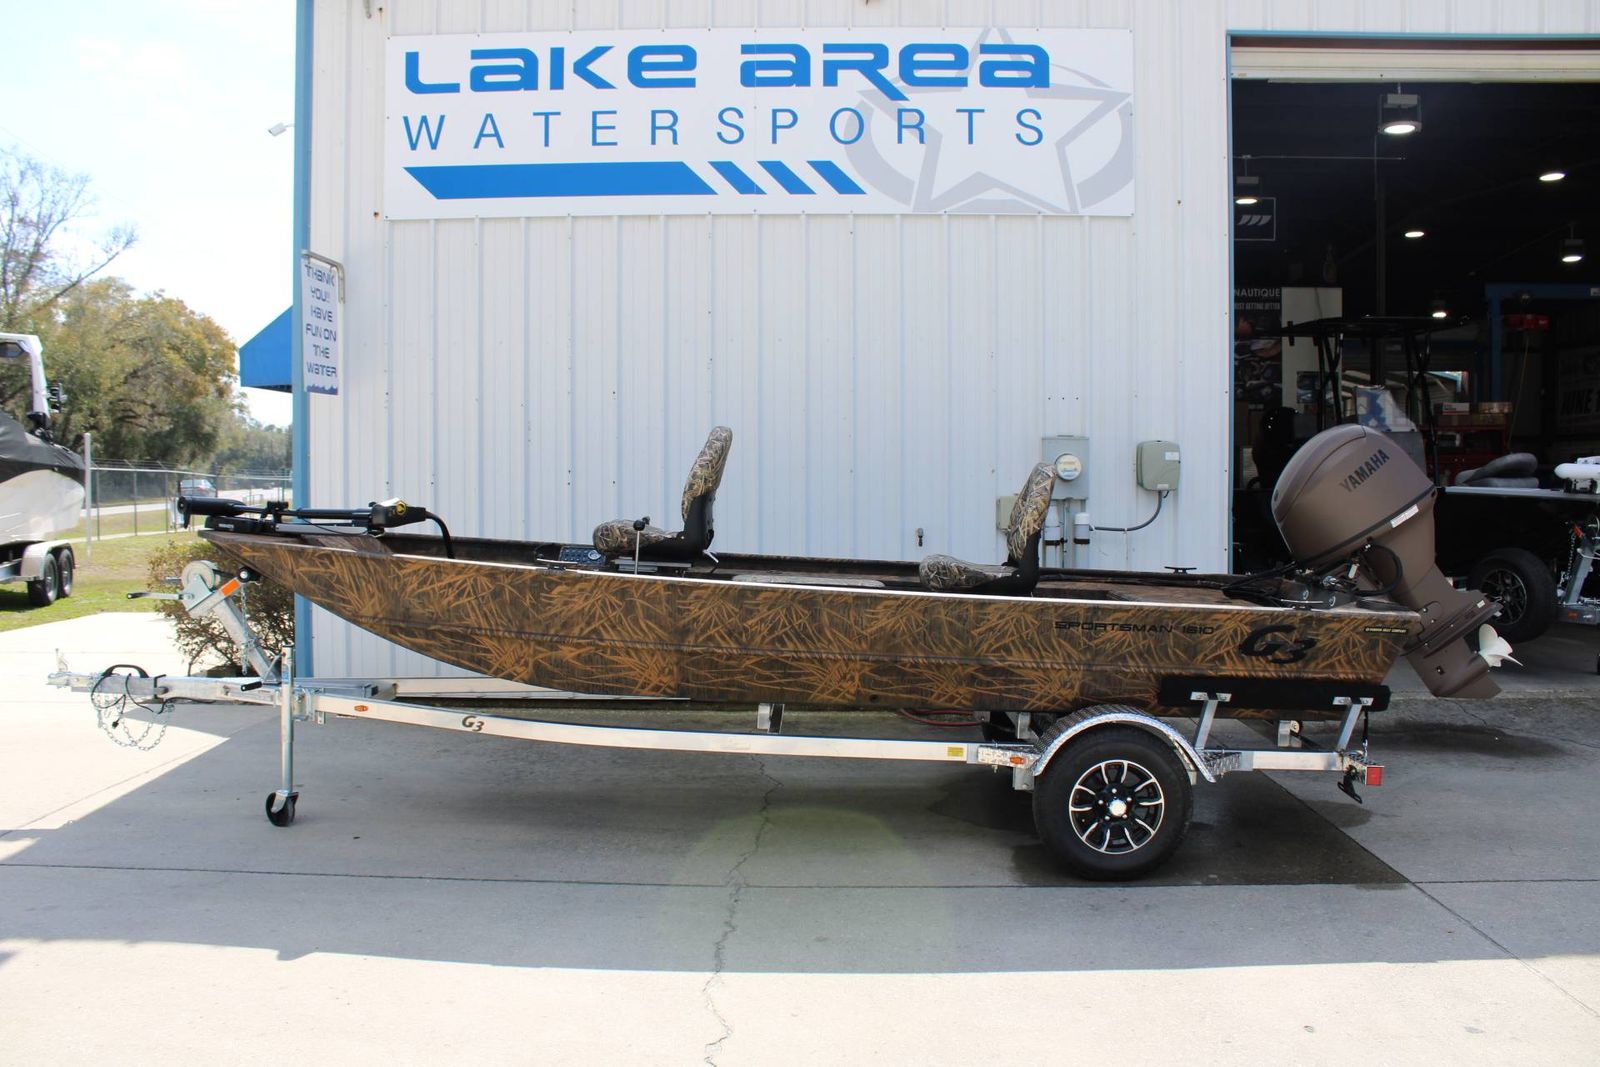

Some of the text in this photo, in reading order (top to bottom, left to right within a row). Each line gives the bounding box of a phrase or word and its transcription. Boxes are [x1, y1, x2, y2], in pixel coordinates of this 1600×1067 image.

[402, 106, 1044, 151] WATERSPORTS
[312, 344, 330, 359] THE
[1339, 449, 1390, 493] YAMAHA
[1054, 621, 1173, 633] SPORTSMAN
[461, 715, 485, 732] G3
